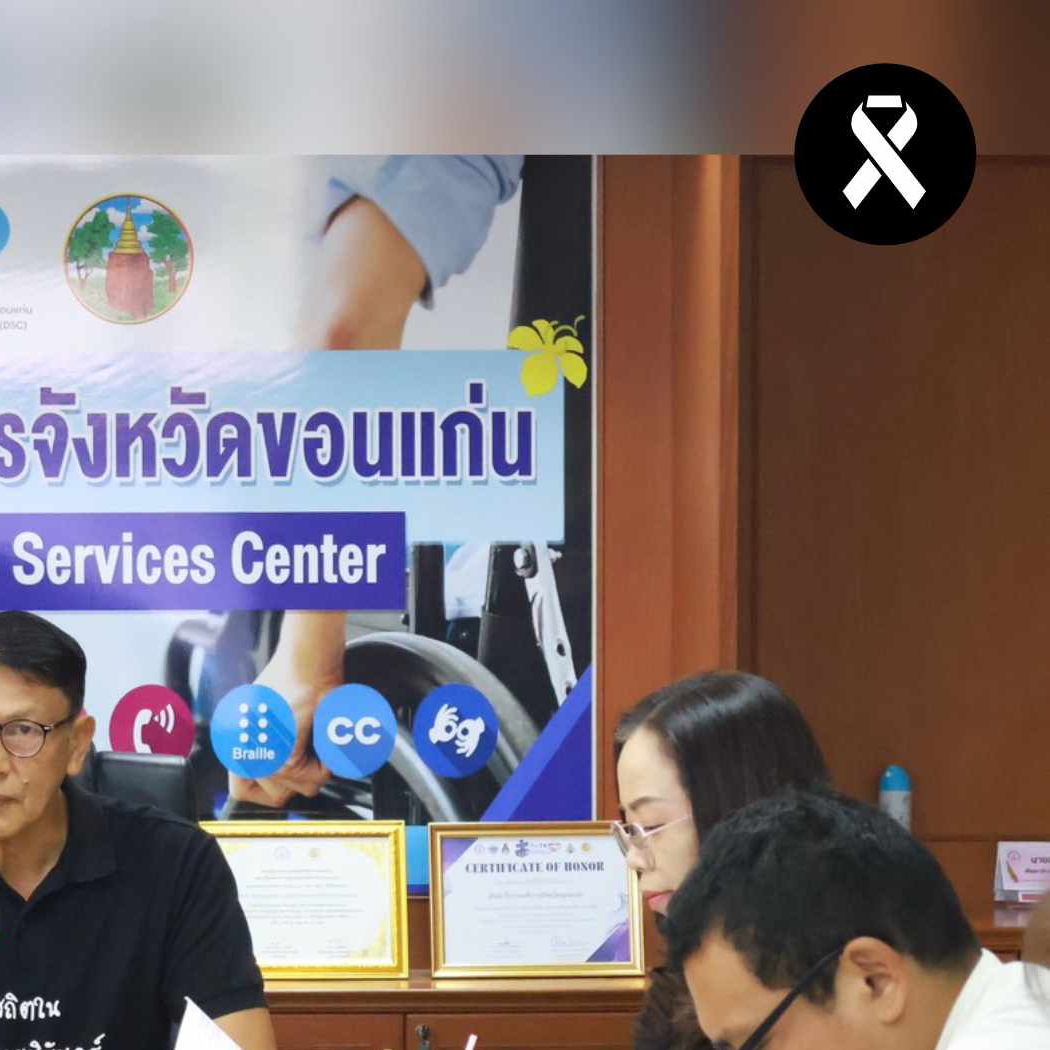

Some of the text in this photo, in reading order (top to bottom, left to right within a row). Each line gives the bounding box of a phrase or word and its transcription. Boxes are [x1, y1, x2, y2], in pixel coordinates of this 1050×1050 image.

[0, 320, 28, 332] (DSC)
[12, 531, 216, 585] Services
[231, 531, 387, 585] Center
[232, 747, 275, 760] Braille
[465, 861, 605, 873] CERTIFICATE OF HONOR
